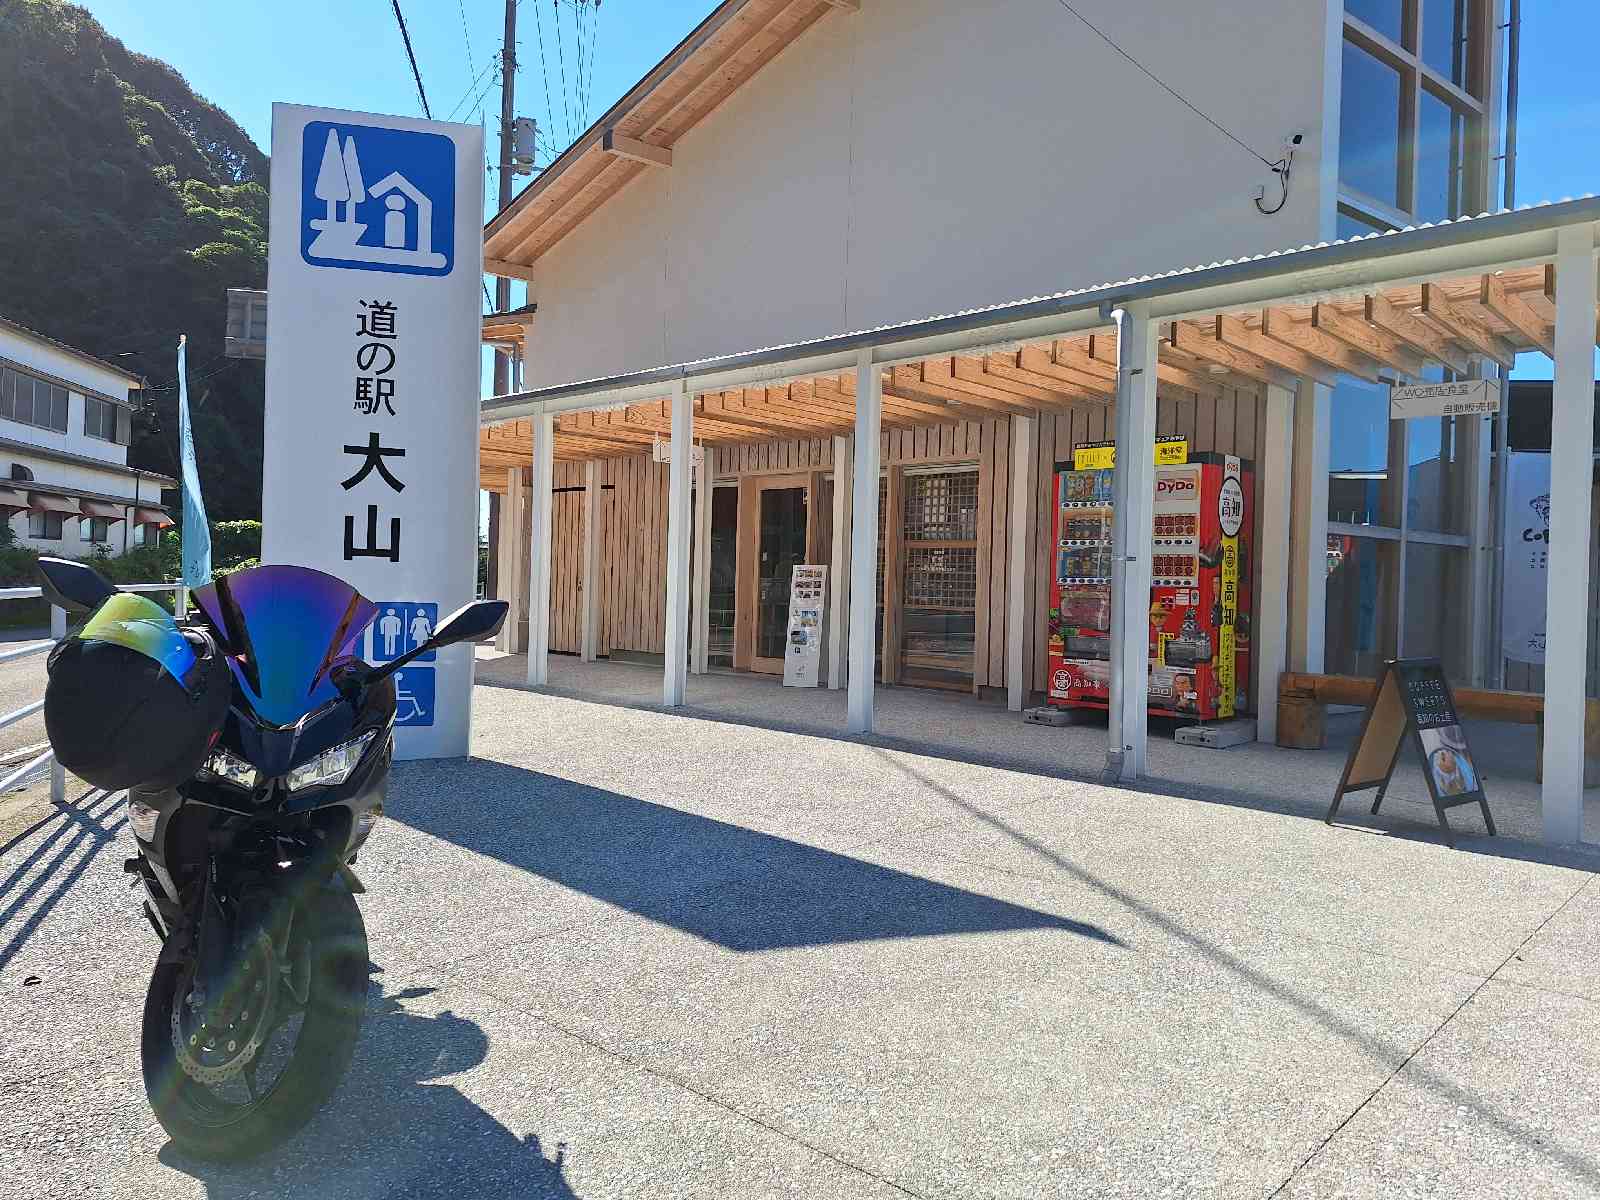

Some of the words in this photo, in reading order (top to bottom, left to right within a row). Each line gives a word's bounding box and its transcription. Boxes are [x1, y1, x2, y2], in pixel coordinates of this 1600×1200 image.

[354, 300, 398, 417] 道の駅
[341, 432, 406, 563] 大山
[1157, 480, 1194, 493] DyDo
